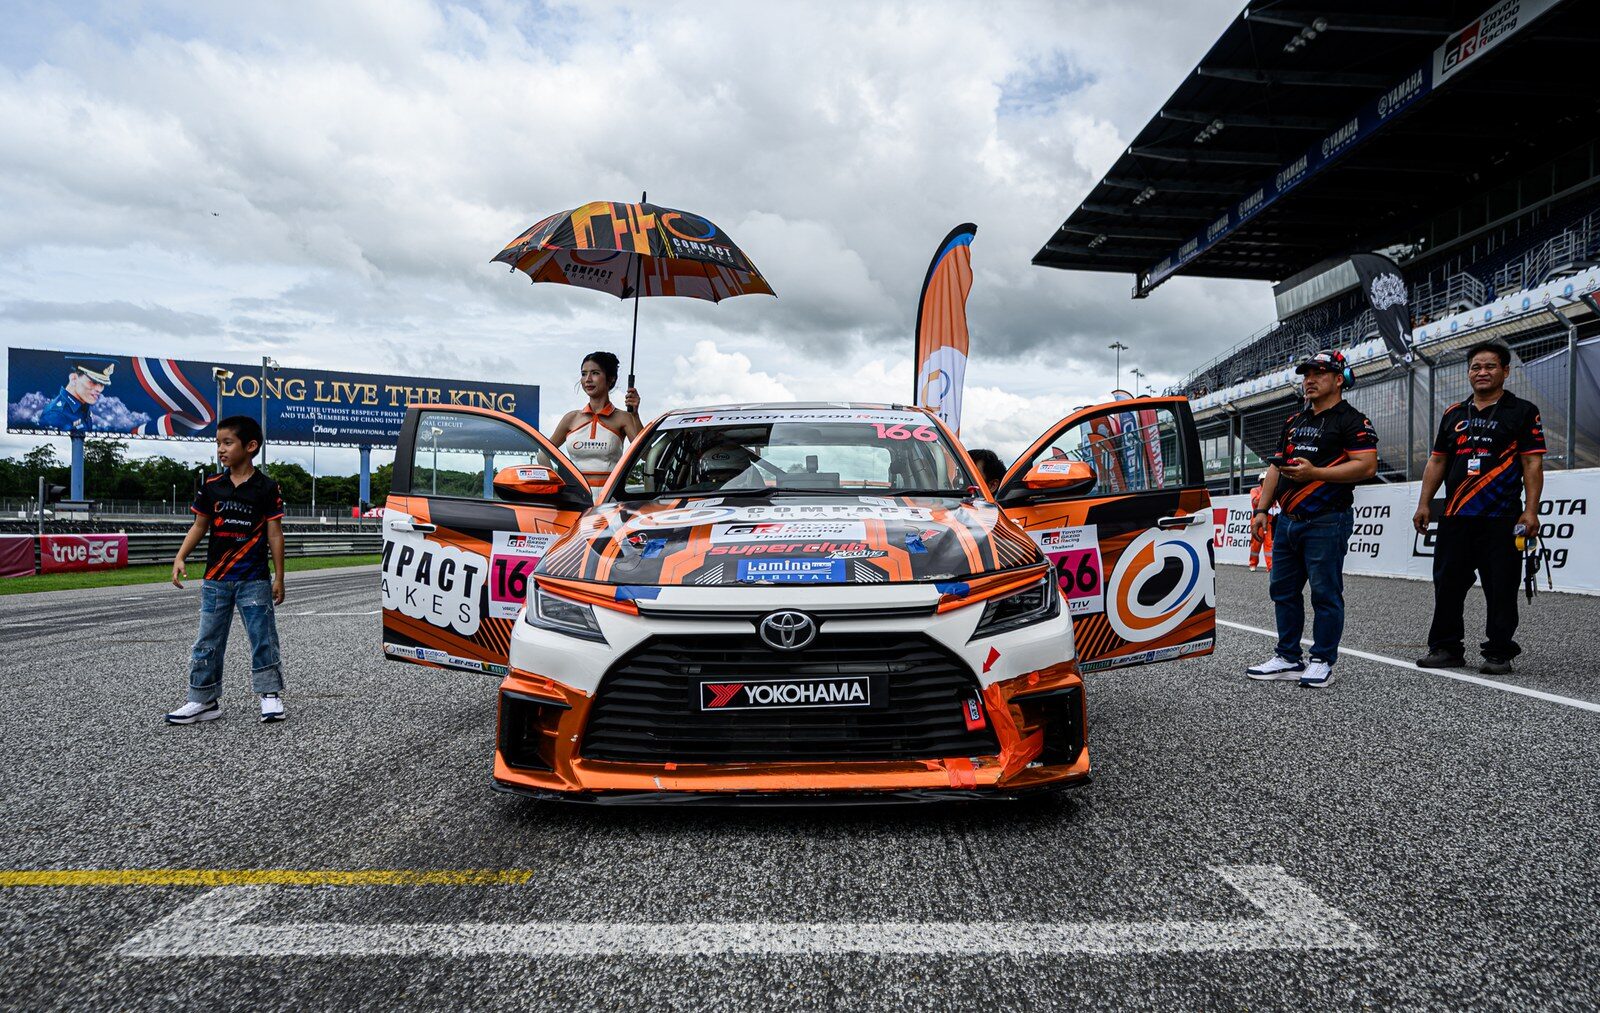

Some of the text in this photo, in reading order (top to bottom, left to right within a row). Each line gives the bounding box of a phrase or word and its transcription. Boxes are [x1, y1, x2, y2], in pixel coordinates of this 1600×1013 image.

[1480, 5, 1520, 37] GAZOO
[1483, 0, 1519, 25] TOYO
[1479, 17, 1518, 49] Racing
[1443, 28, 1478, 73] GR
[1388, 69, 1423, 108] YAMAHA
[1330, 117, 1358, 150] YAMAHA
[672, 238, 731, 257] COMPACT
[564, 263, 613, 279] COMPACT
[221, 376, 517, 413] LONG LIVE THE KING
[286, 405, 305, 413] WITH
[306, 406, 321, 414] THE
[321, 407, 350, 415] UTMOST
[351, 408, 379, 417] RESPECT
[380, 410, 399, 418] FROM
[856, 414, 914, 422] Racing
[312, 425, 338, 435] Chang
[340, 428, 385, 436] INTERNATIONAL
[870, 422, 939, 443] 166
[507, 536, 527, 547] GR
[1041, 533, 1060, 545] GR
[51, 541, 119, 565] true 5G
[747, 559, 811, 571] Lamina
[1069, 600, 1090, 609] TIV
[448, 658, 481, 669] LENSO
[1112, 653, 1147, 665] LENSO
[744, 682, 865, 704] YOKOHAMA
